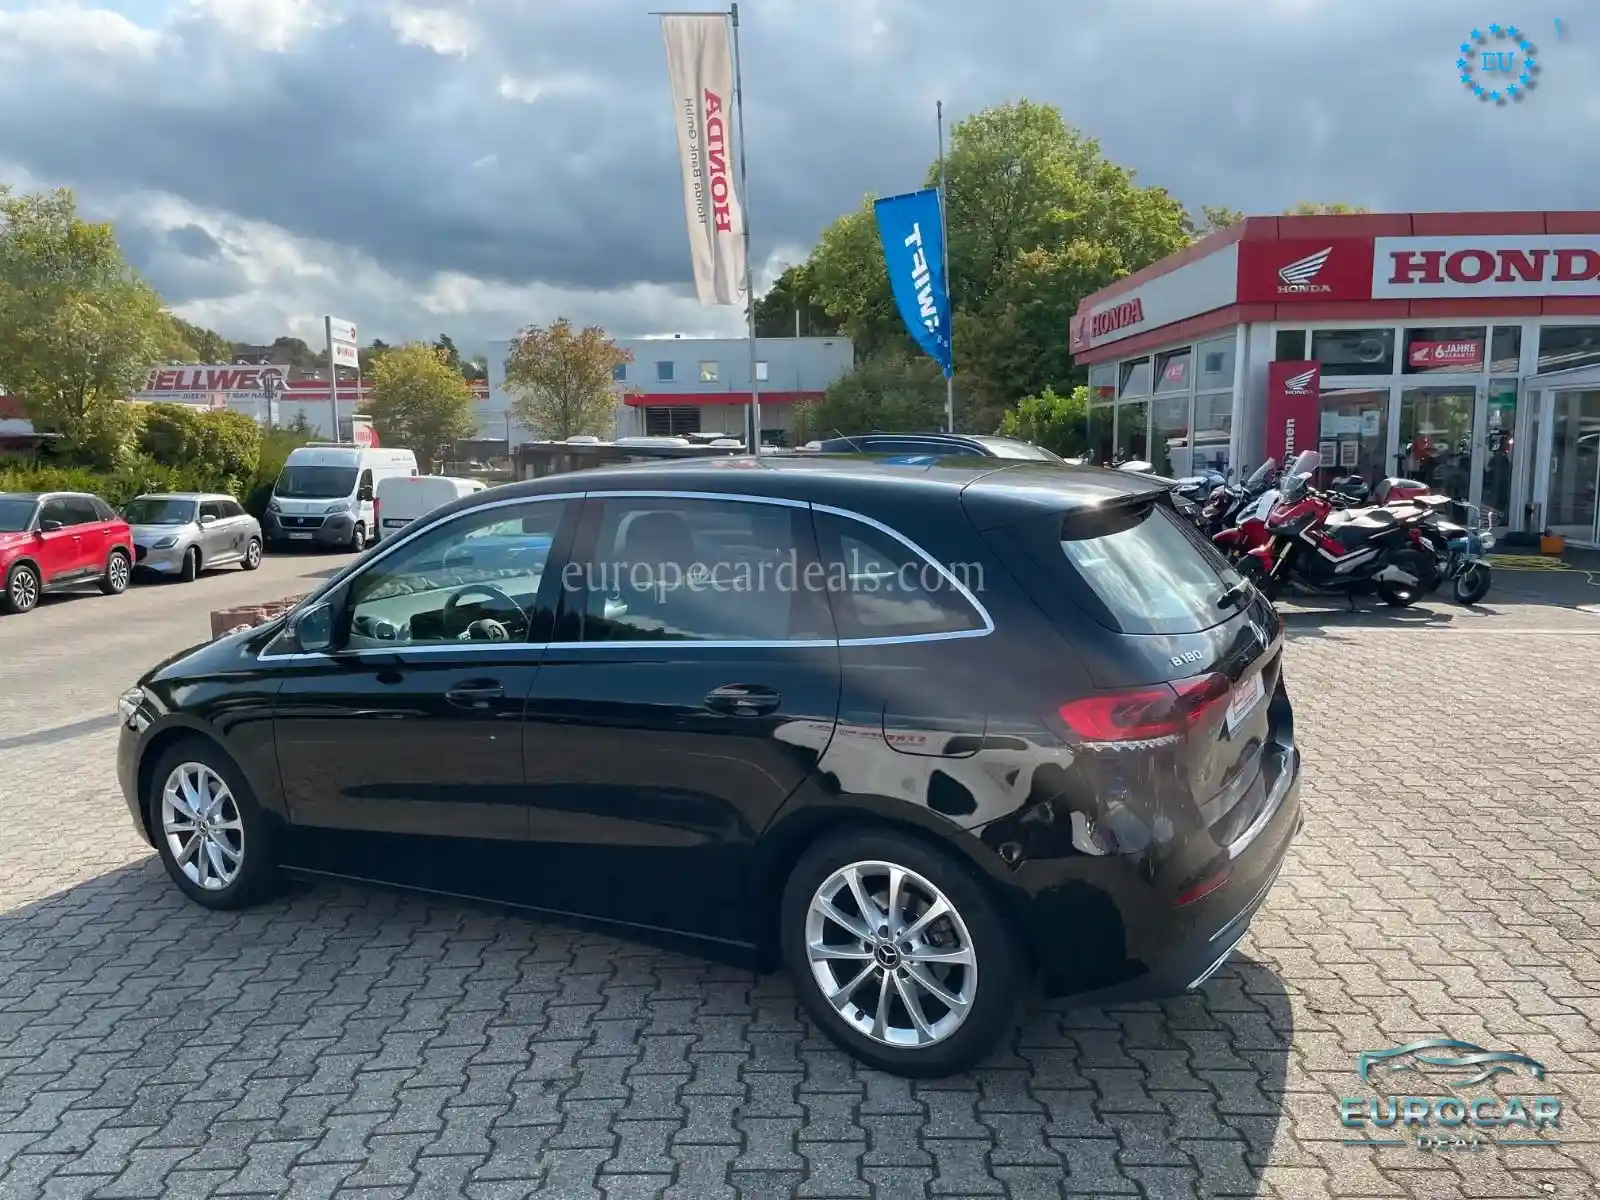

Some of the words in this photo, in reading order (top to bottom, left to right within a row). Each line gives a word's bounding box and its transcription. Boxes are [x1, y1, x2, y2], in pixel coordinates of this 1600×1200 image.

[1388, 249, 1600, 284] HOND
[1277, 284, 1332, 293] HONDA
[1091, 298, 1144, 338] HONDA
[1435, 344, 1445, 359] 6
[1444, 343, 1476, 353] JAHRE
